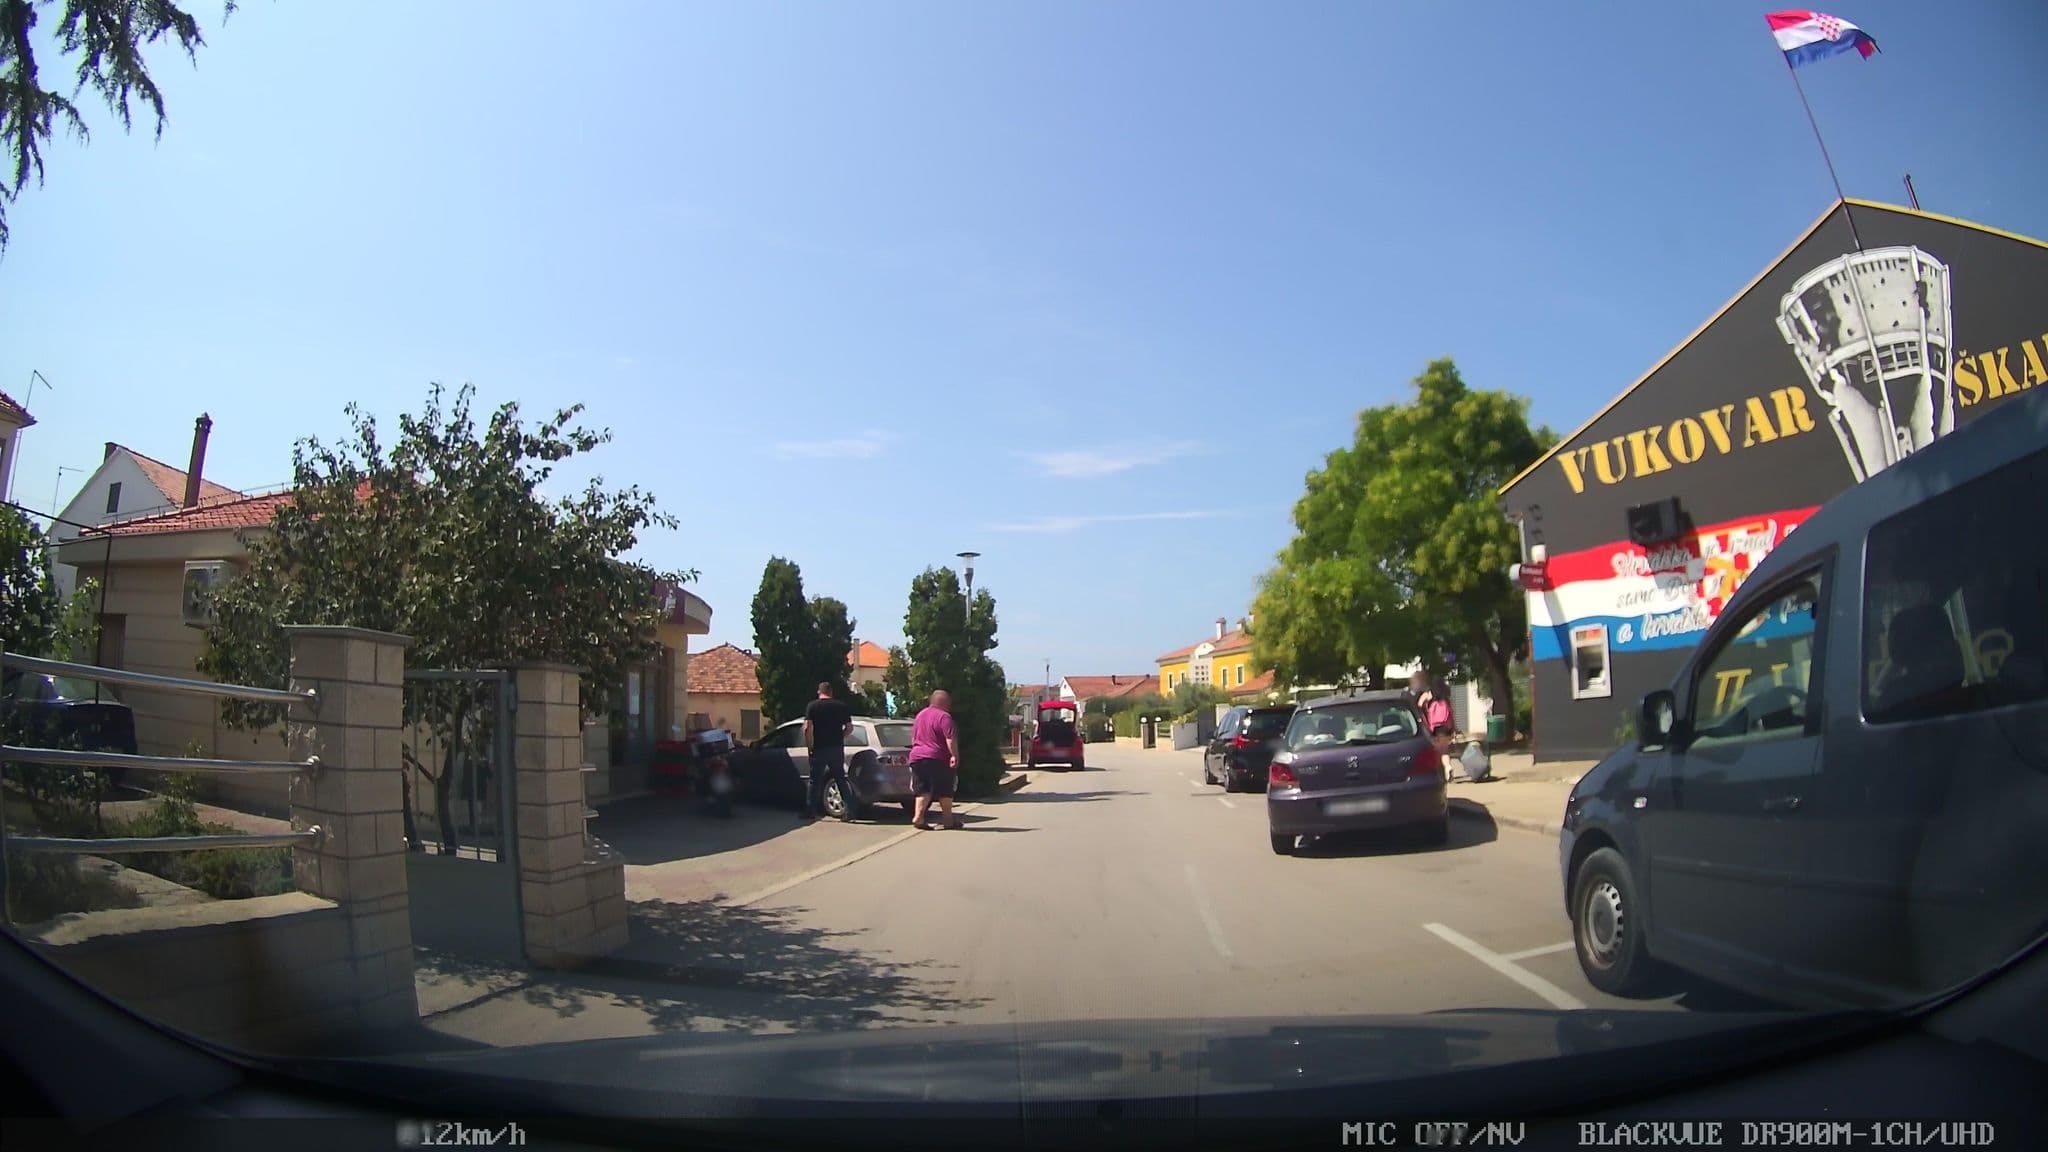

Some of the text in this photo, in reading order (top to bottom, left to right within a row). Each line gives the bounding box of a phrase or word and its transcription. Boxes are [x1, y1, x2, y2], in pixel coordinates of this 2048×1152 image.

[1556, 334, 2048, 494] VUKOVAR ŠKA
[1616, 622, 1634, 643] a
